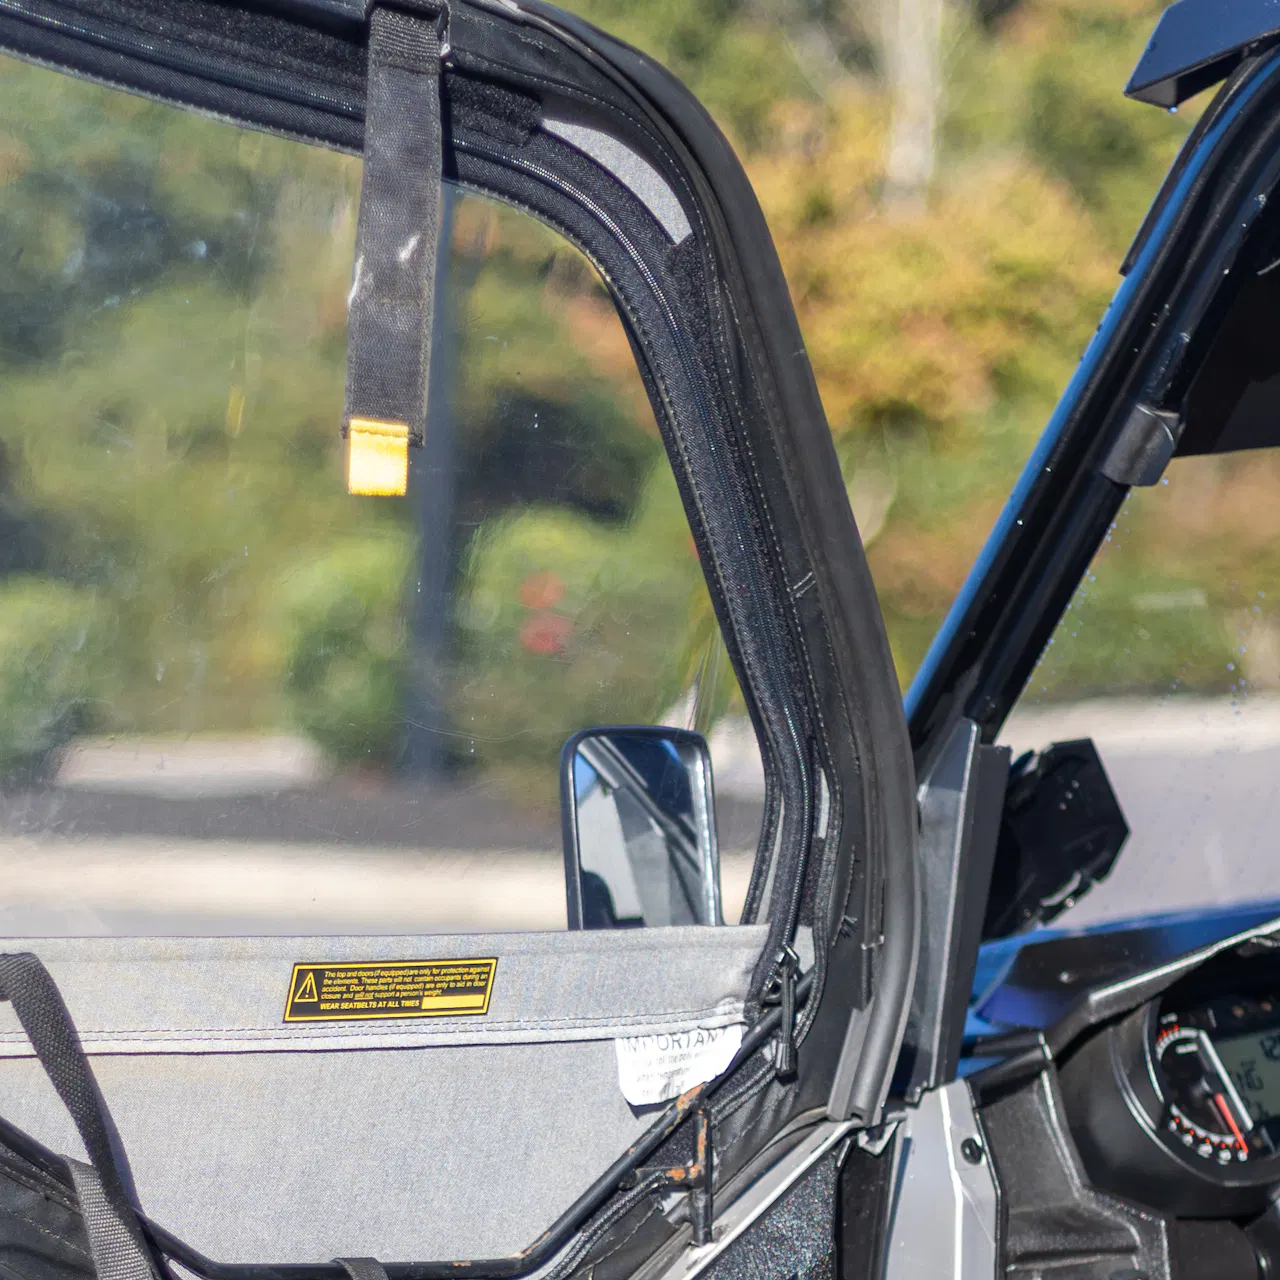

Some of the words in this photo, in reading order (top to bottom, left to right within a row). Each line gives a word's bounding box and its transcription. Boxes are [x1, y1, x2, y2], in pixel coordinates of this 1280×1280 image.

[441, 967, 469, 975] protection
[470, 966, 489, 974] against
[320, 1002, 339, 1010] WEAR
[341, 1001, 376, 1009] SEATBELTS
[388, 1000, 399, 1008] ALL
[401, 999, 420, 1007] TIMES
